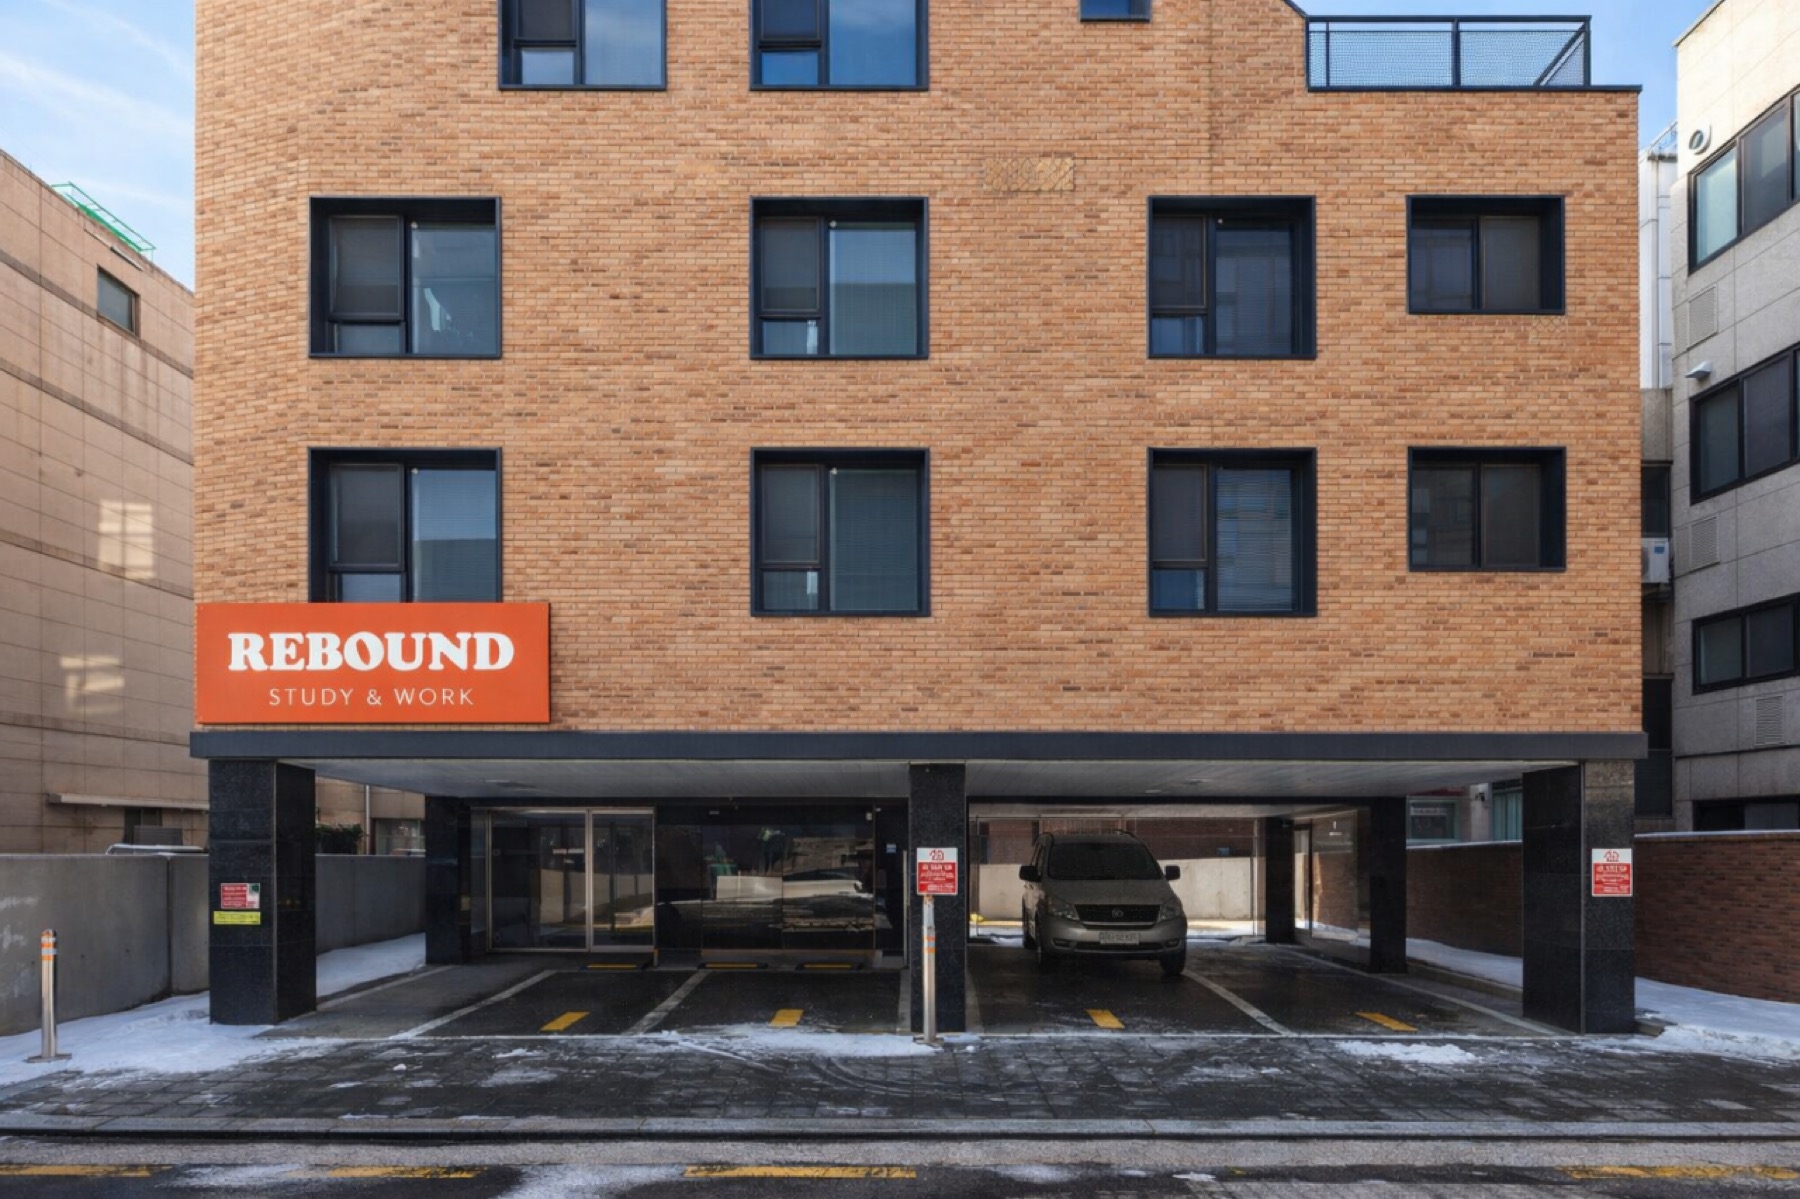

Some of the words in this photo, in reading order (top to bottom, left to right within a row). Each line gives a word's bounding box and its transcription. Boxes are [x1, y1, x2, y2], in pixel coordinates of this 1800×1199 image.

[228, 631, 515, 671] REBOUND
[269, 688, 354, 705] STUDY
[366, 688, 382, 705] &
[394, 688, 474, 705] WORK
